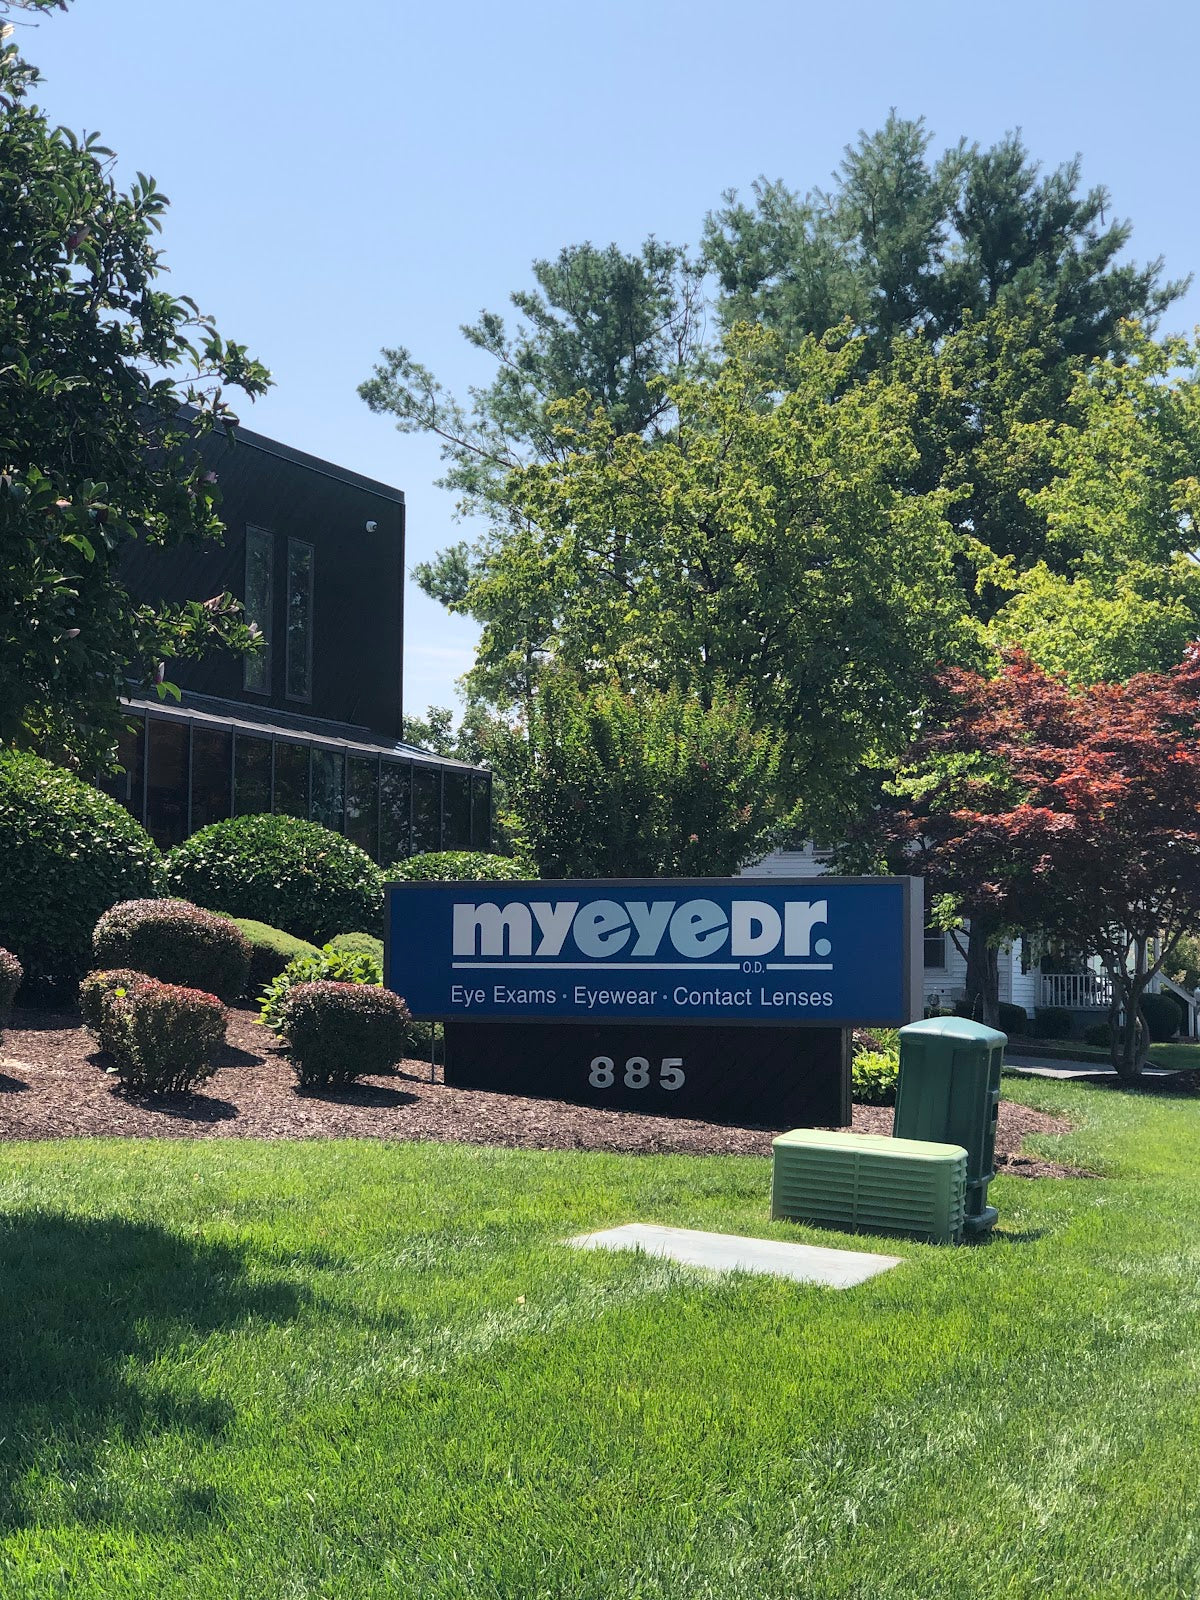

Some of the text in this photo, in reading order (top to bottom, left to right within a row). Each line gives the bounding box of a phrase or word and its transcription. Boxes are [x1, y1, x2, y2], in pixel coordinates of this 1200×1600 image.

[742, 961, 765, 974] O.D.
[451, 985, 833, 1009] Eye Exams Eyewear Contact Lenses
[588, 1056, 687, 1091] 885
